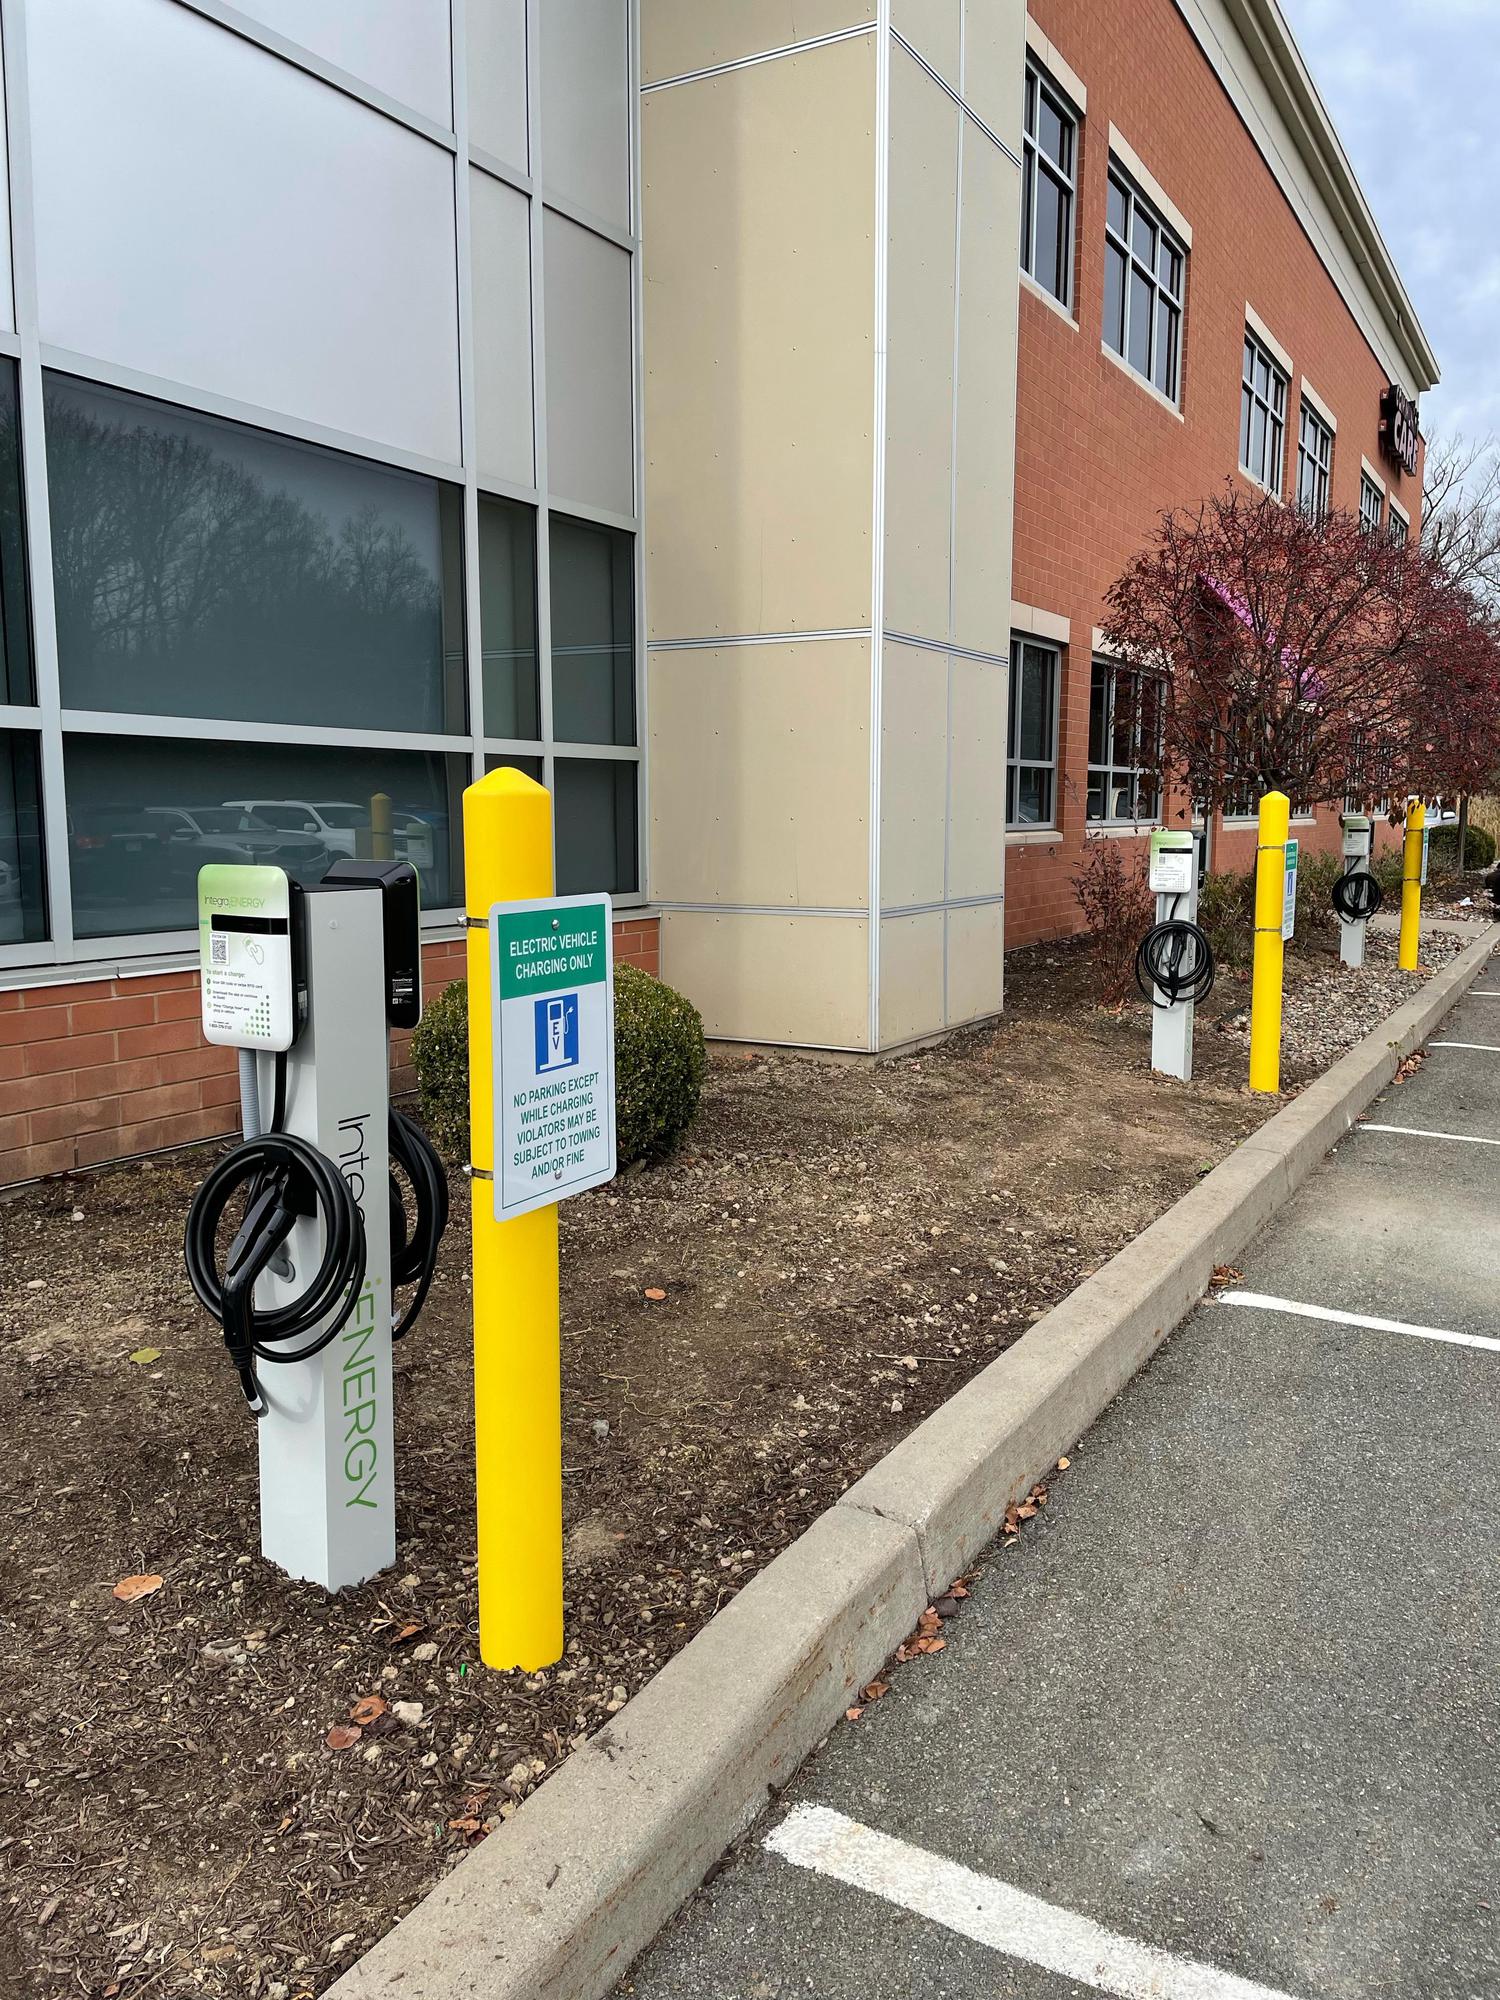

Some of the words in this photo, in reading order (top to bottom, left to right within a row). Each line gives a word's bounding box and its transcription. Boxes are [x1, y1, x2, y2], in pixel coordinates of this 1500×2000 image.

[1394, 411, 1419, 475] CARE
[510, 934, 557, 957] ELECTRIC
[559, 930, 598, 949] VEHICLE
[515, 957, 568, 980] CHARGING
[569, 952, 594, 971] ONLY
[552, 1021, 560, 1051] EV
[513, 1092, 527, 1108] NO
[529, 1081, 567, 1103] PARKING
[568, 1072, 599, 1091] EXCEPT
[520, 1107, 549, 1125] WHILE
[550, 1092, 594, 1115] CHARGING
[517, 1120, 566, 1145] VIOLATORS
[567, 1115, 585, 1131] MAY
[586, 1108, 597, 1122] BE
[513, 1140, 553, 1166] SUBJECT
[555, 1138, 567, 1152] TO
[568, 1125, 600, 1147] TOWING
[531, 1159, 564, 1180] AND/OR
[566, 1148, 585, 1167] FINE
[341, 1294, 379, 1509] ENERGY
